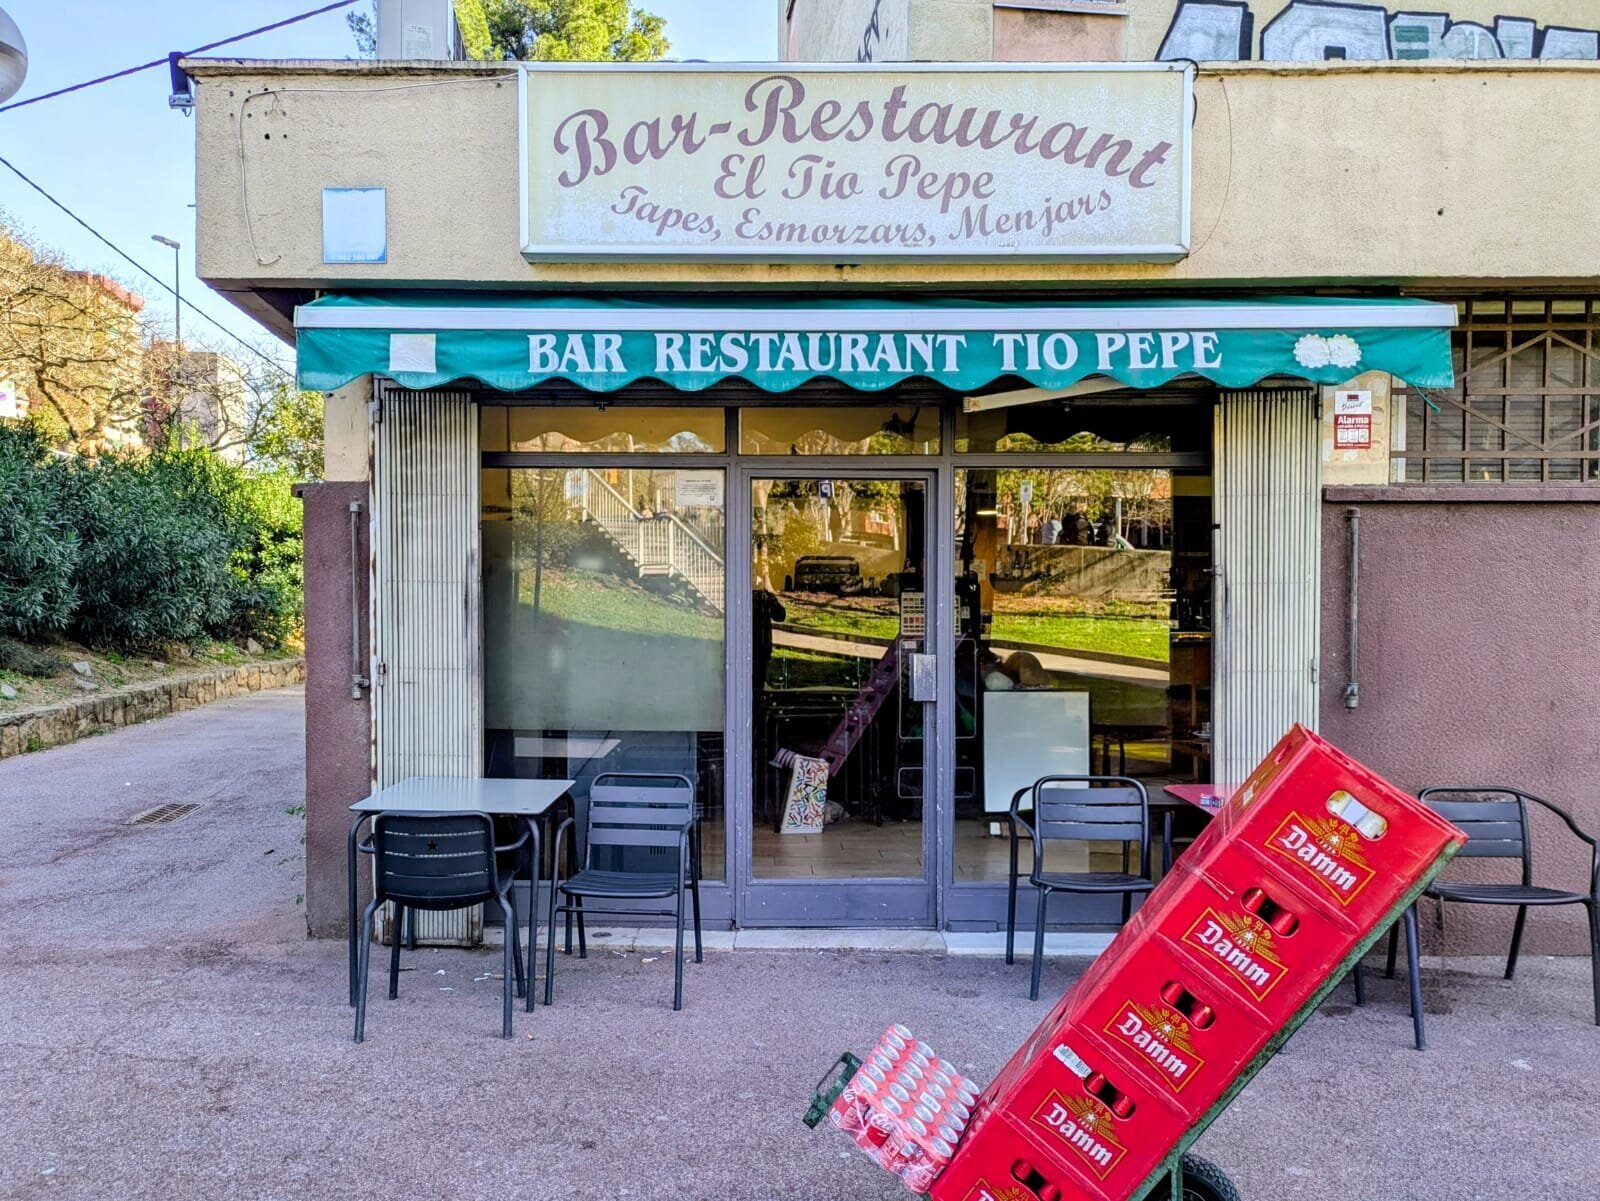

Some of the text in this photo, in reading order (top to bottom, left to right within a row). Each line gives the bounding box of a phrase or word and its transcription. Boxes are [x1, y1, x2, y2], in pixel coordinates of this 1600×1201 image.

[554, 75, 1172, 190] Bar-Restaurant
[714, 154, 995, 213] El Tio Pepe
[611, 186, 1111, 248] Tapes, Esmorzars, Menjars
[528, 332, 1221, 372] BAR RESTAURANT TIO PEPE
[1337, 415, 1369, 425] Alarma
[1279, 825, 1357, 890] Damm
[1196, 920, 1270, 986] Damm
[1116, 1012, 1188, 1078] Damm
[1042, 1103, 1113, 1167] Damm
